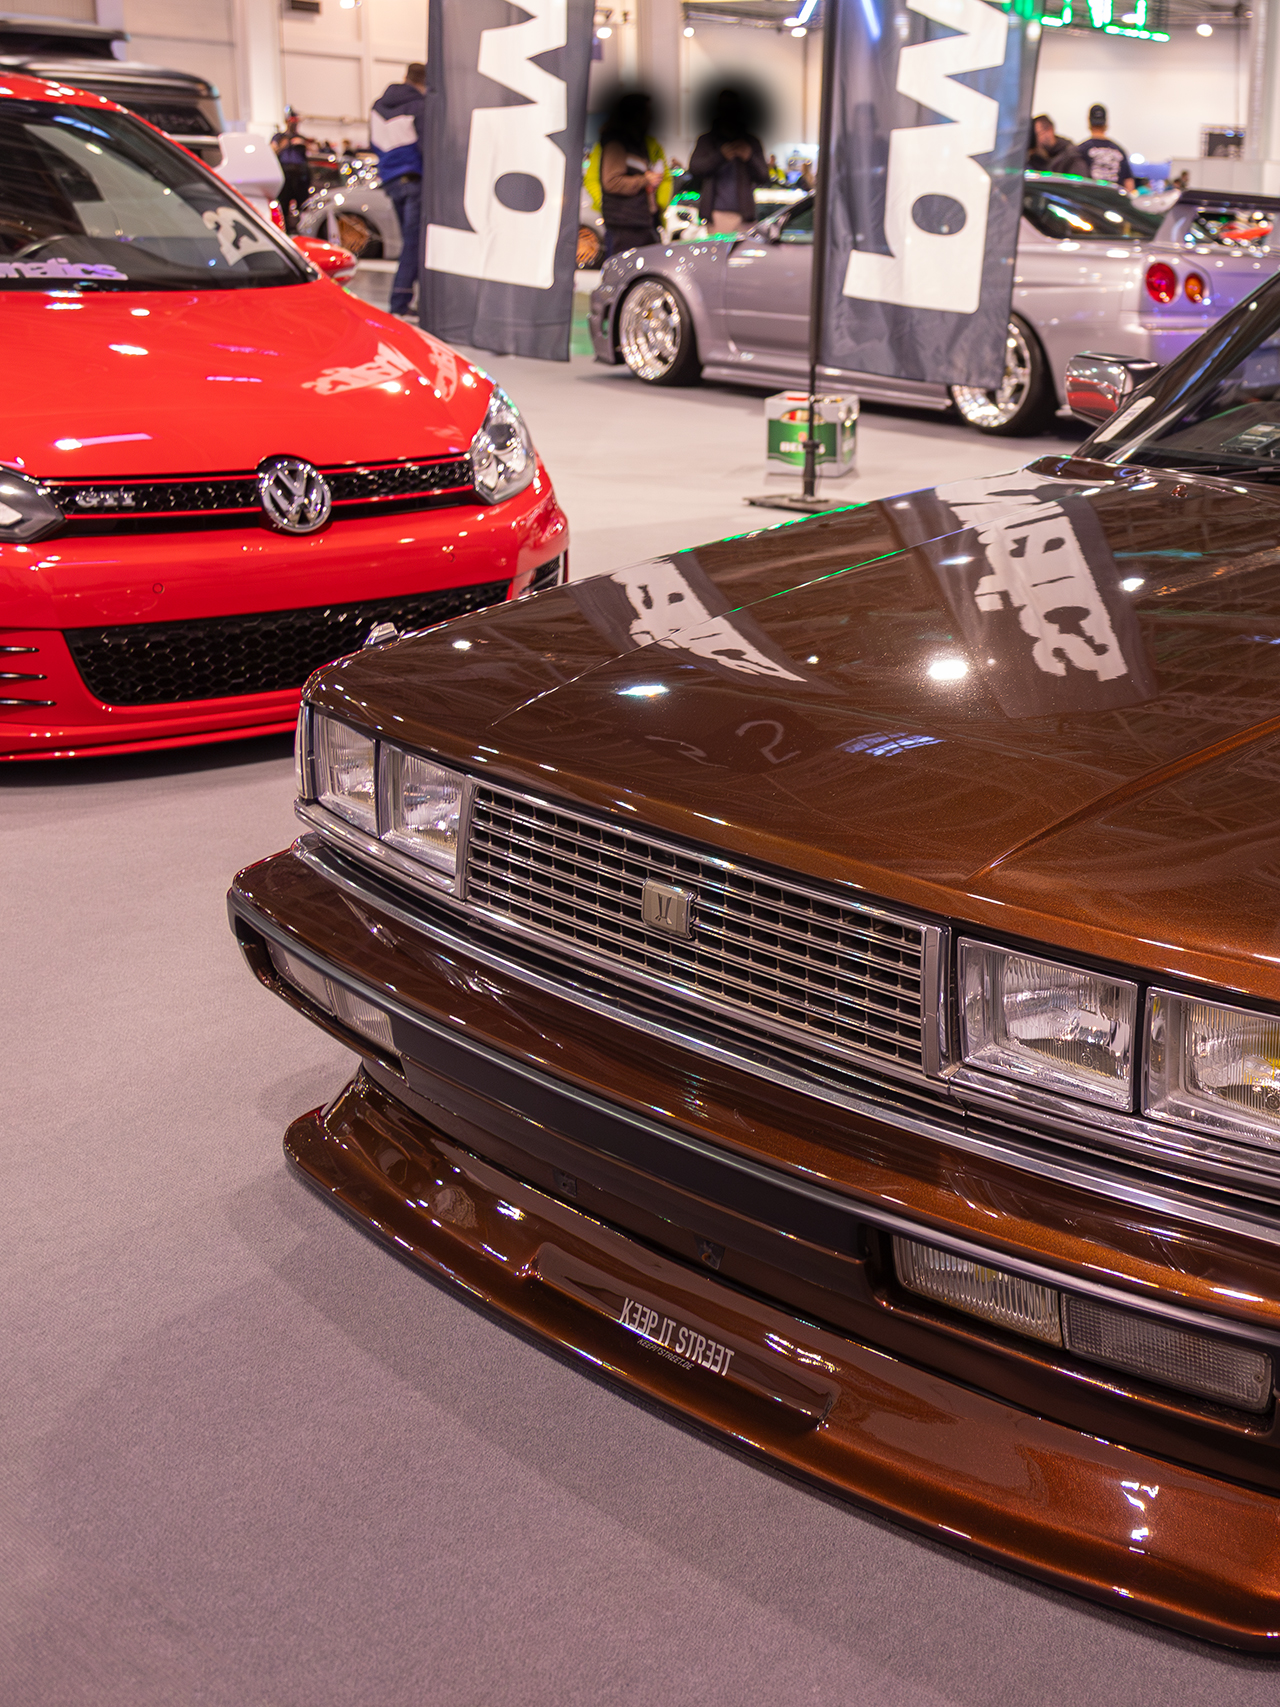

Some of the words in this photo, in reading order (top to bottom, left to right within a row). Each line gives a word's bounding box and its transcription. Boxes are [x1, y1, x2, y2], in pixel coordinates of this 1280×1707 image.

[75, 491, 136, 508] GTI
[658, 1317, 677, 1347] IT
[636, 1338, 695, 1371] KEEPITSTREET.DE
